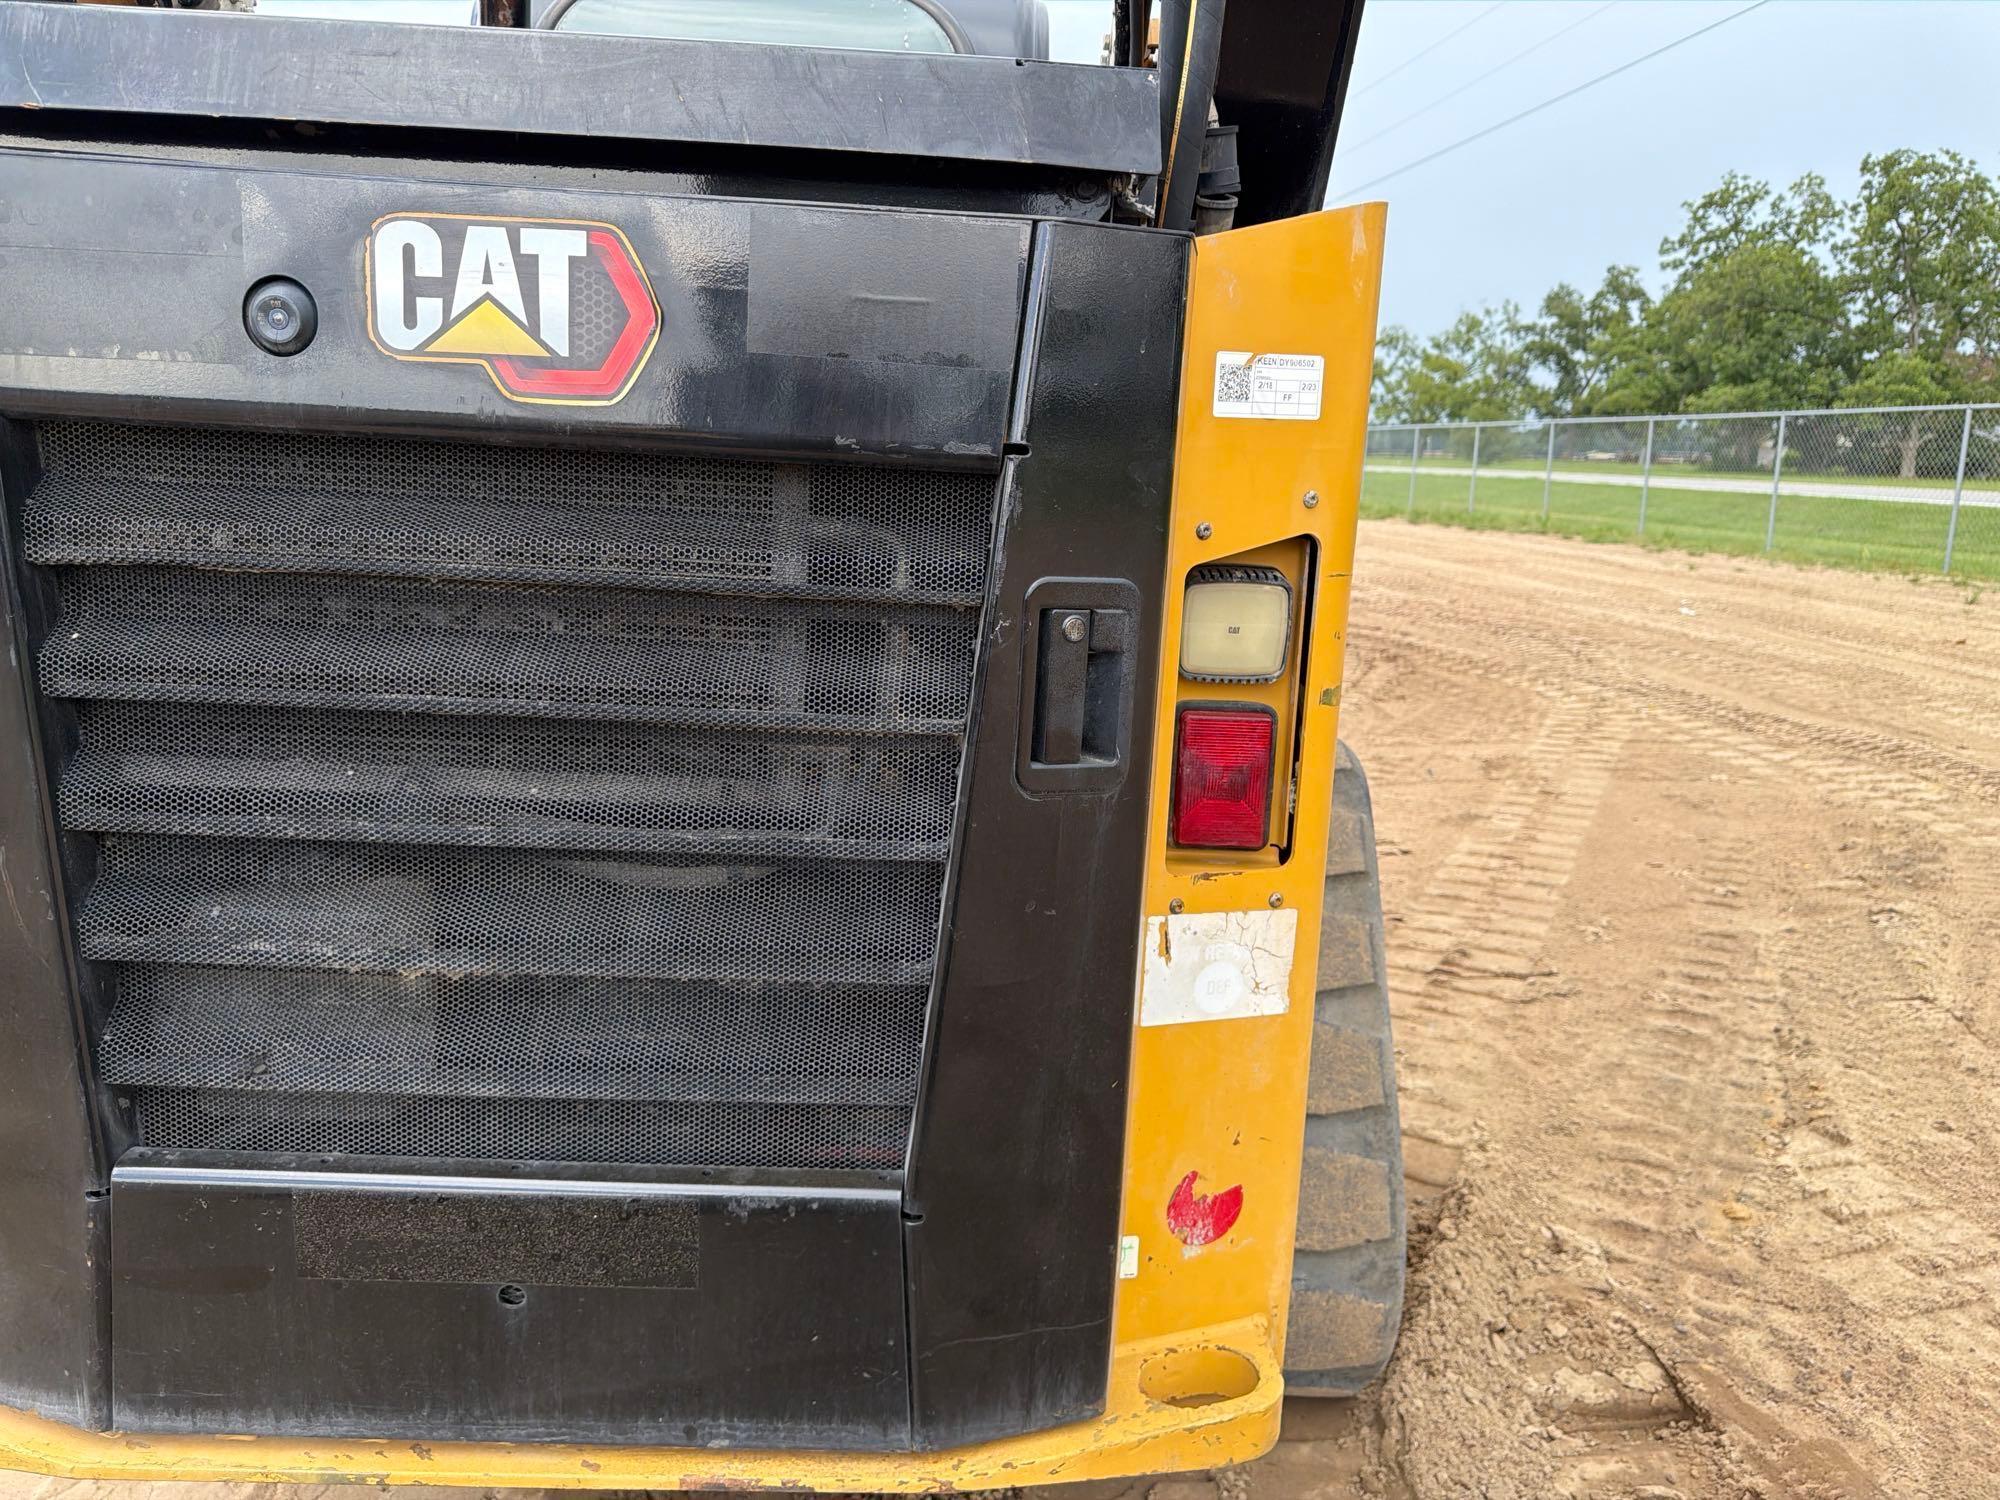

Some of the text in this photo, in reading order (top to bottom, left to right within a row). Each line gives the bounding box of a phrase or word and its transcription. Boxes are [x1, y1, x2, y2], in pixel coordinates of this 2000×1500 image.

[374, 220, 588, 358] CAT
[1256, 356, 1277, 366] KEEN
[1301, 383, 1317, 391] 2/23
[1228, 626, 1240, 635] CAT
